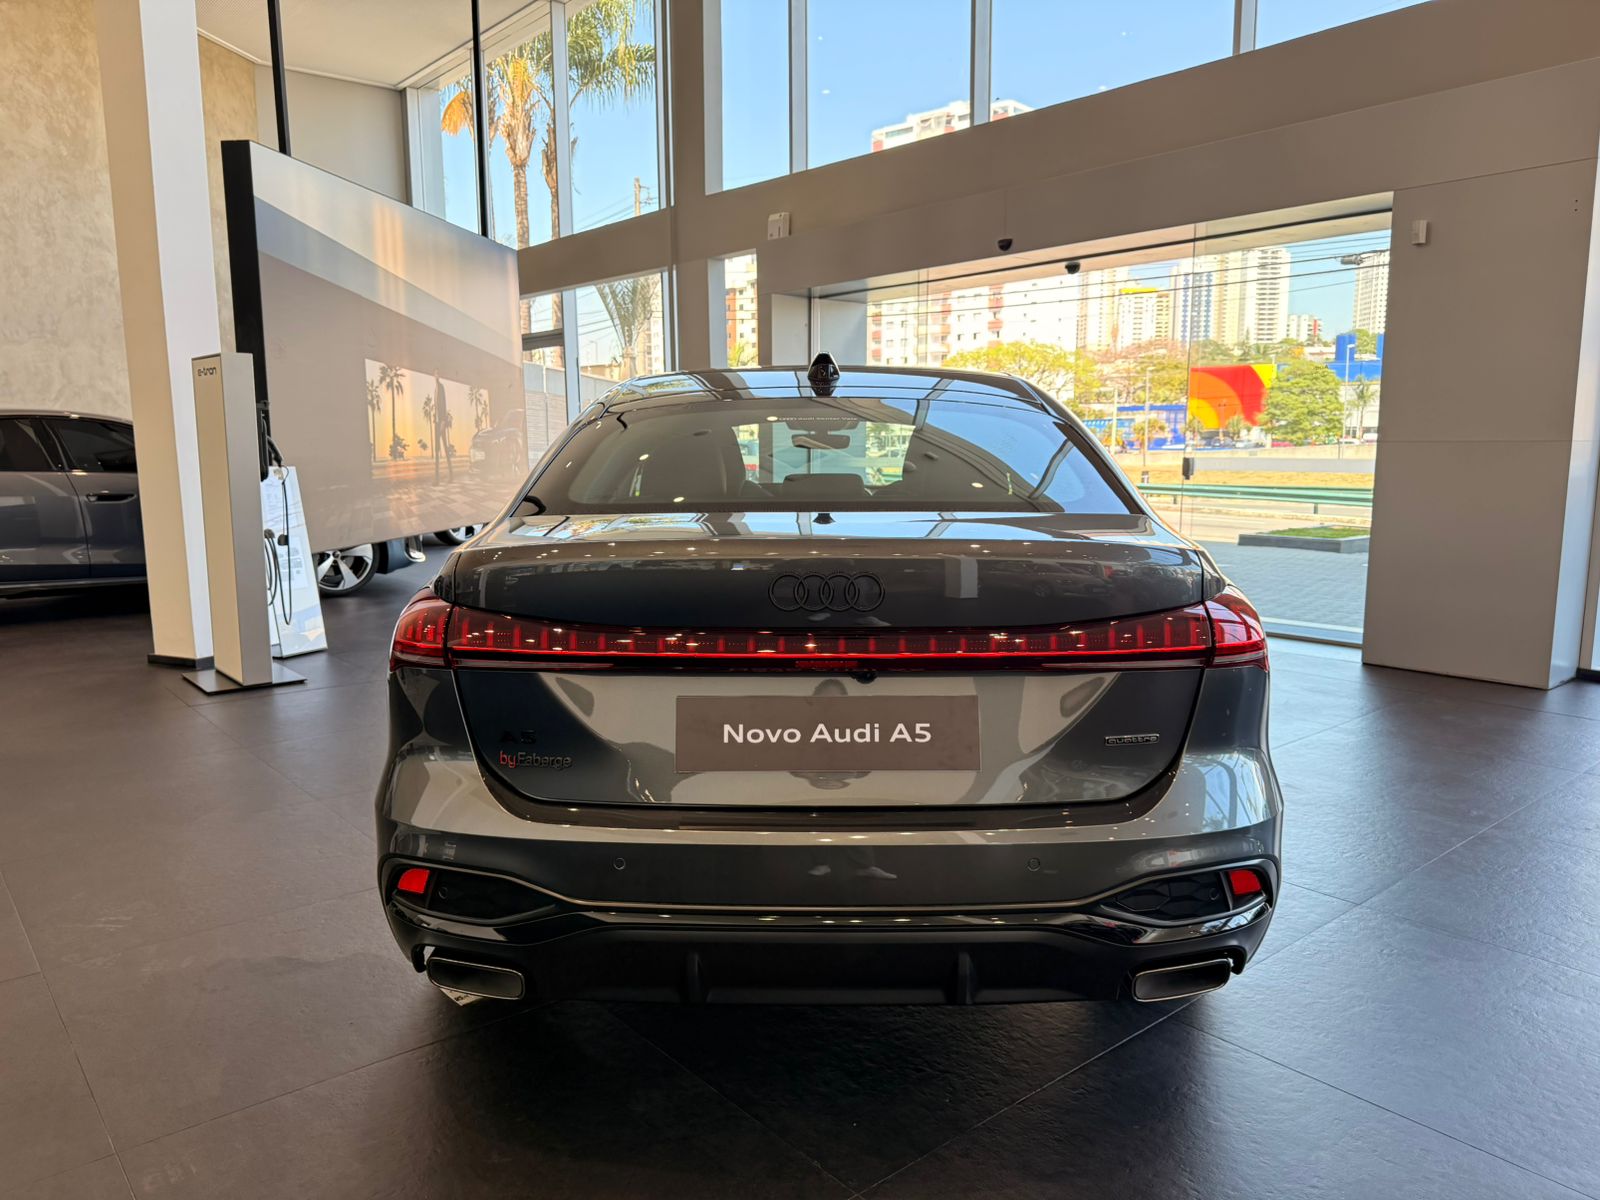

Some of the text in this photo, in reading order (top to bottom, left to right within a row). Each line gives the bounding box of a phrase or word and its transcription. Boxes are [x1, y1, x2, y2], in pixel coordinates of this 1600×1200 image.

[499, 730, 537, 745] A5
[722, 722, 932, 744] Novo Audi A5
[1107, 735, 1158, 745] quattro
